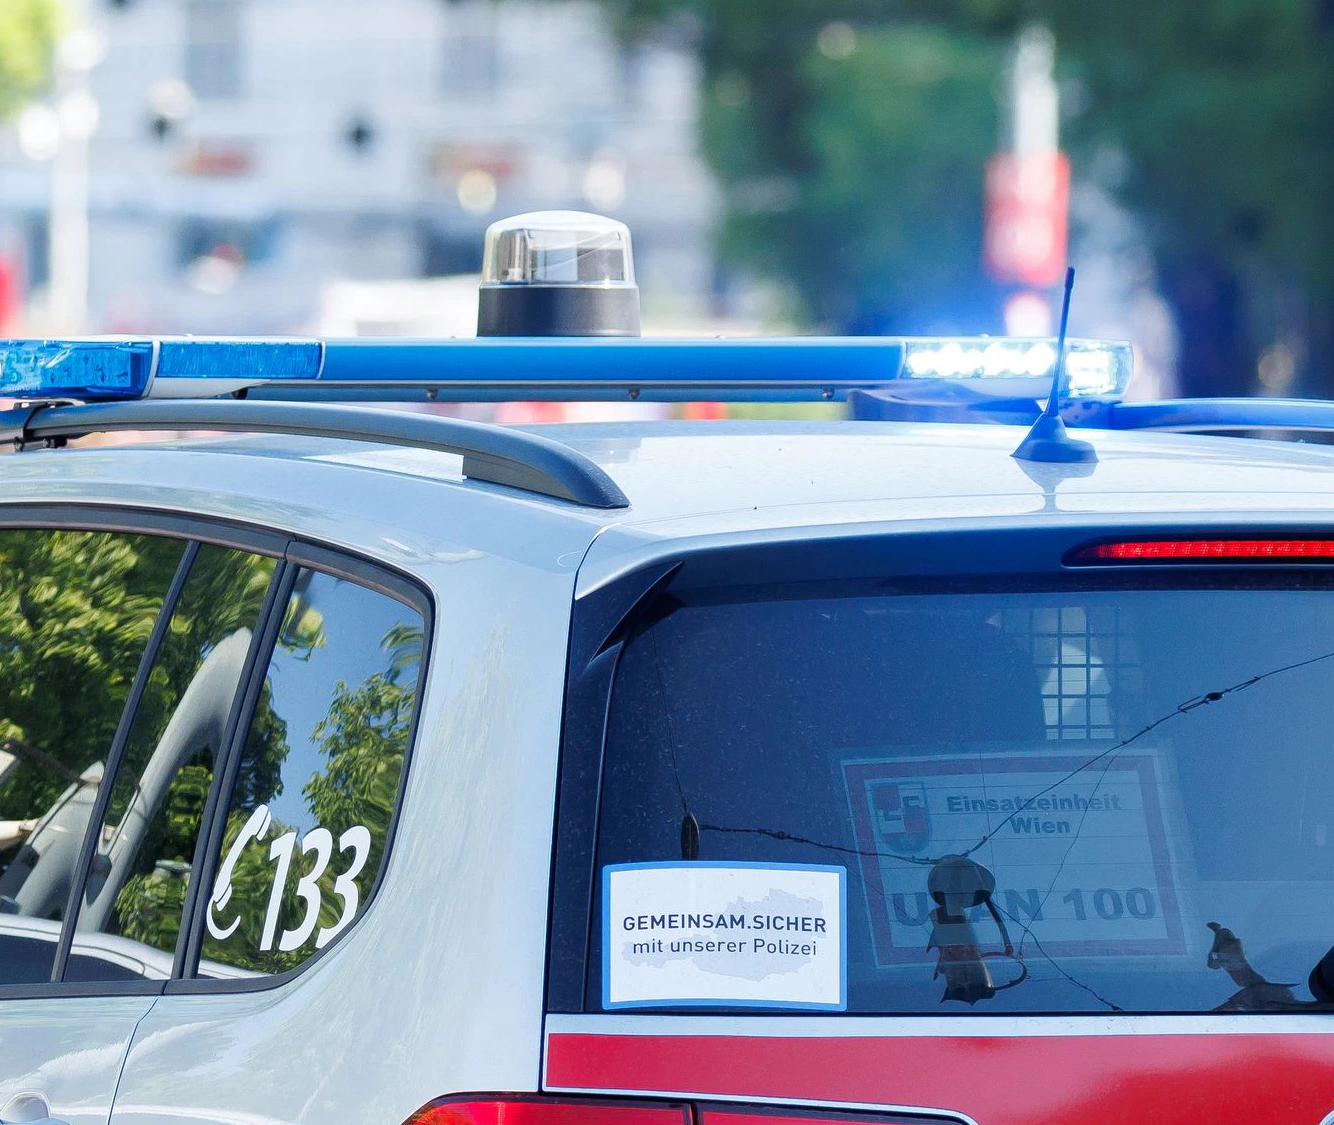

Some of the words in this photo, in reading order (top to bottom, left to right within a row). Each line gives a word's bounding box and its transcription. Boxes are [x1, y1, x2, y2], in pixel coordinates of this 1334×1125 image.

[946, 792, 1122, 813] Einsatzeinheit
[1009, 816, 1071, 835] Wien
[260, 825, 371, 951] 133
[1063, 887, 1157, 921] 100
[623, 914, 827, 933] GEMEINSAM.SICHER
[633, 938, 664, 954] mit
[670, 939, 747, 953] unserer
[754, 938, 817, 955] Polizei
